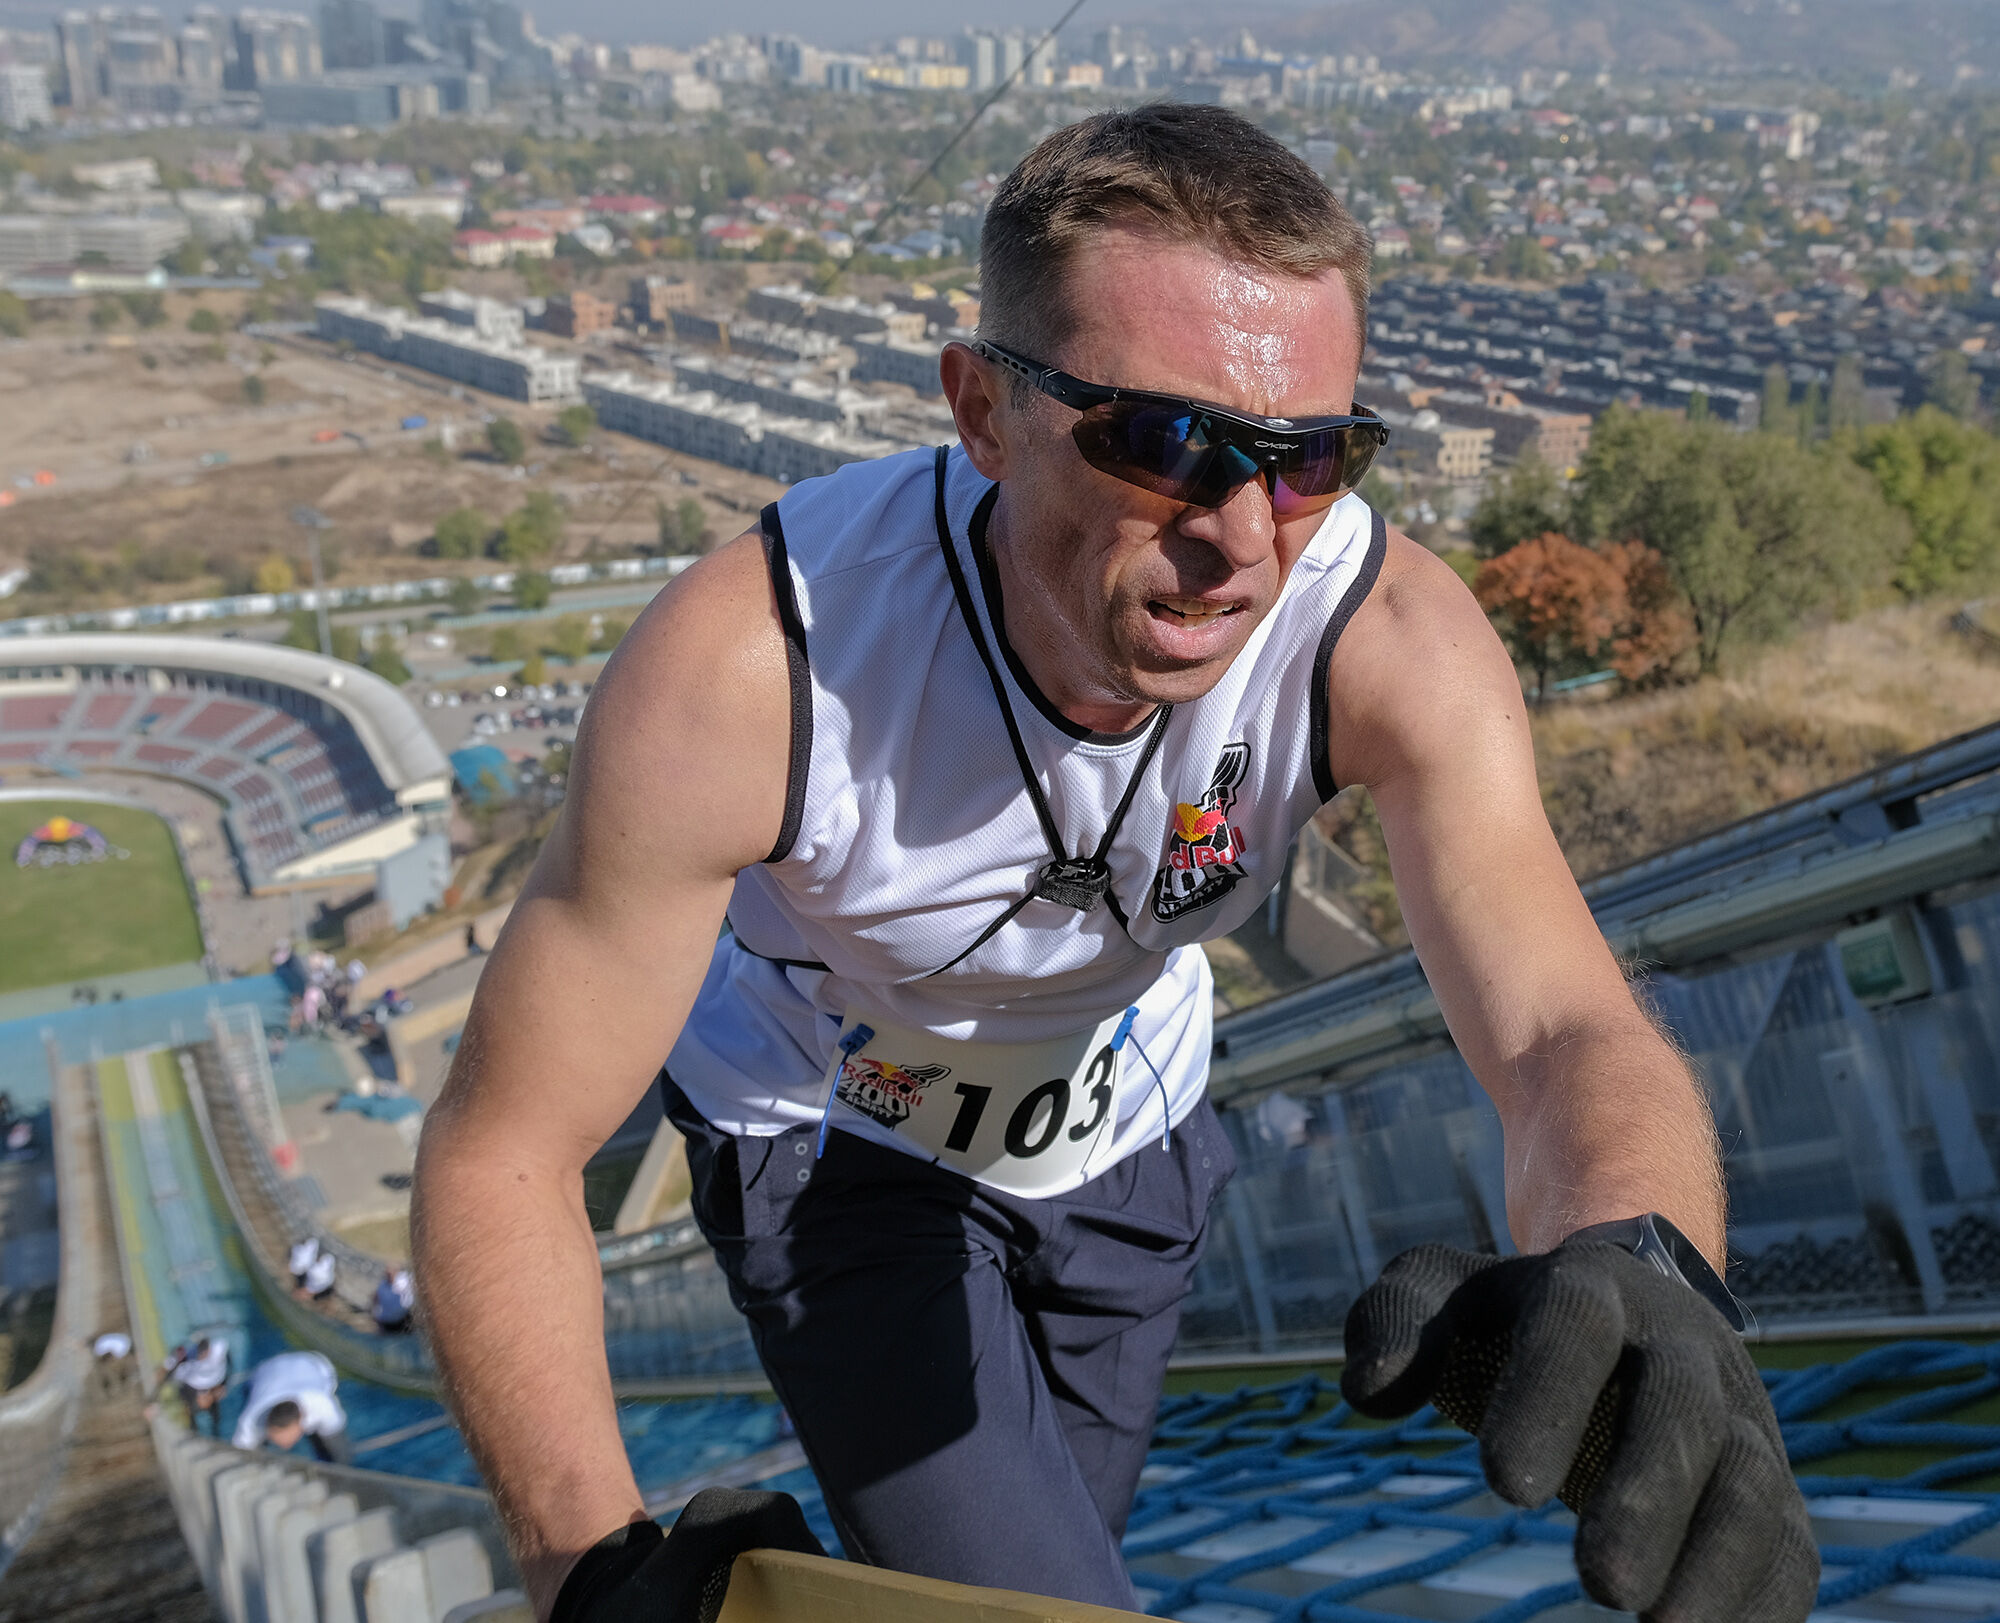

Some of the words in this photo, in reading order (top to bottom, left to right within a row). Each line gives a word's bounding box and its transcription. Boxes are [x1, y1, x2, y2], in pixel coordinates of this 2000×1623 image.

[843, 1062, 884, 1089] Red
[883, 1082, 923, 1107] Bull
[944, 1042, 1115, 1160] 103
